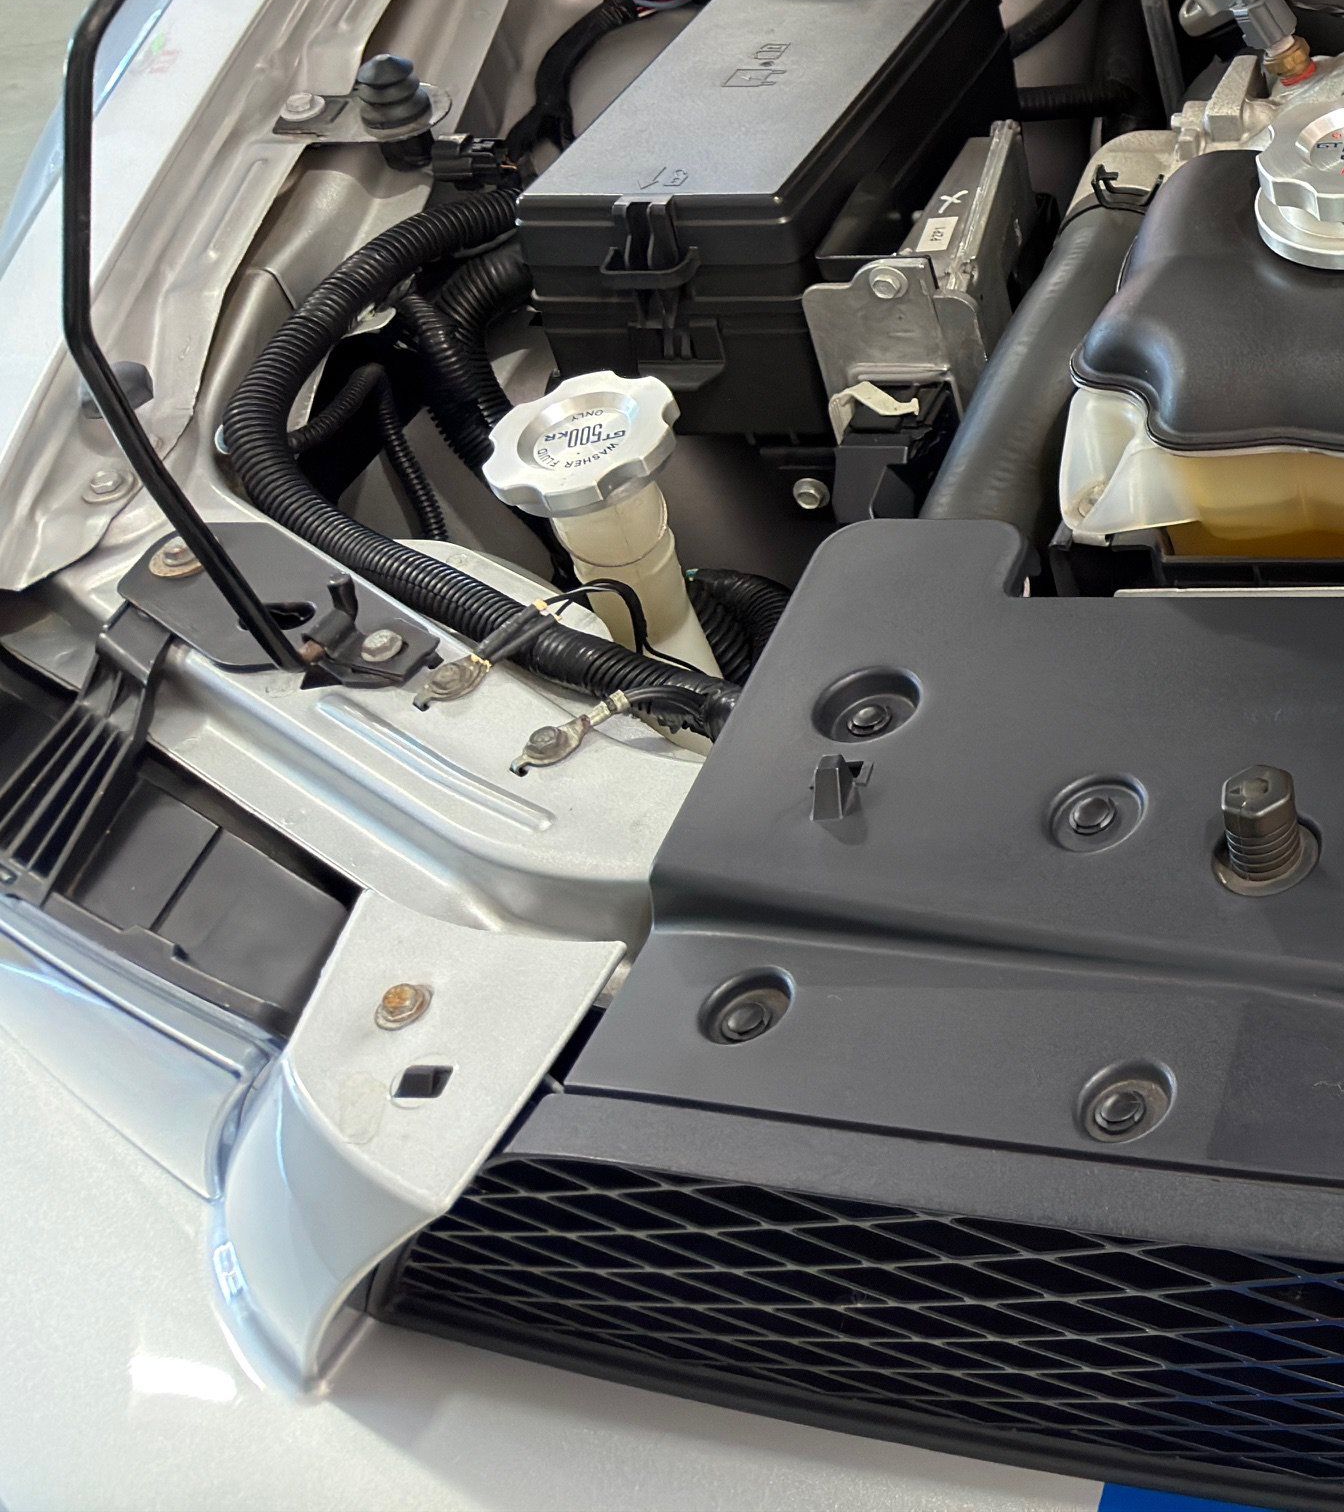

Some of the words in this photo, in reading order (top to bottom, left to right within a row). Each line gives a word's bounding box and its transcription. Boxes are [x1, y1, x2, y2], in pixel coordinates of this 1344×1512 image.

[571, 409, 604, 422] ONLY
[544, 423, 626, 448] GT500KR
[537, 448, 559, 468] FLUID
[565, 443, 619, 468] WASHER
